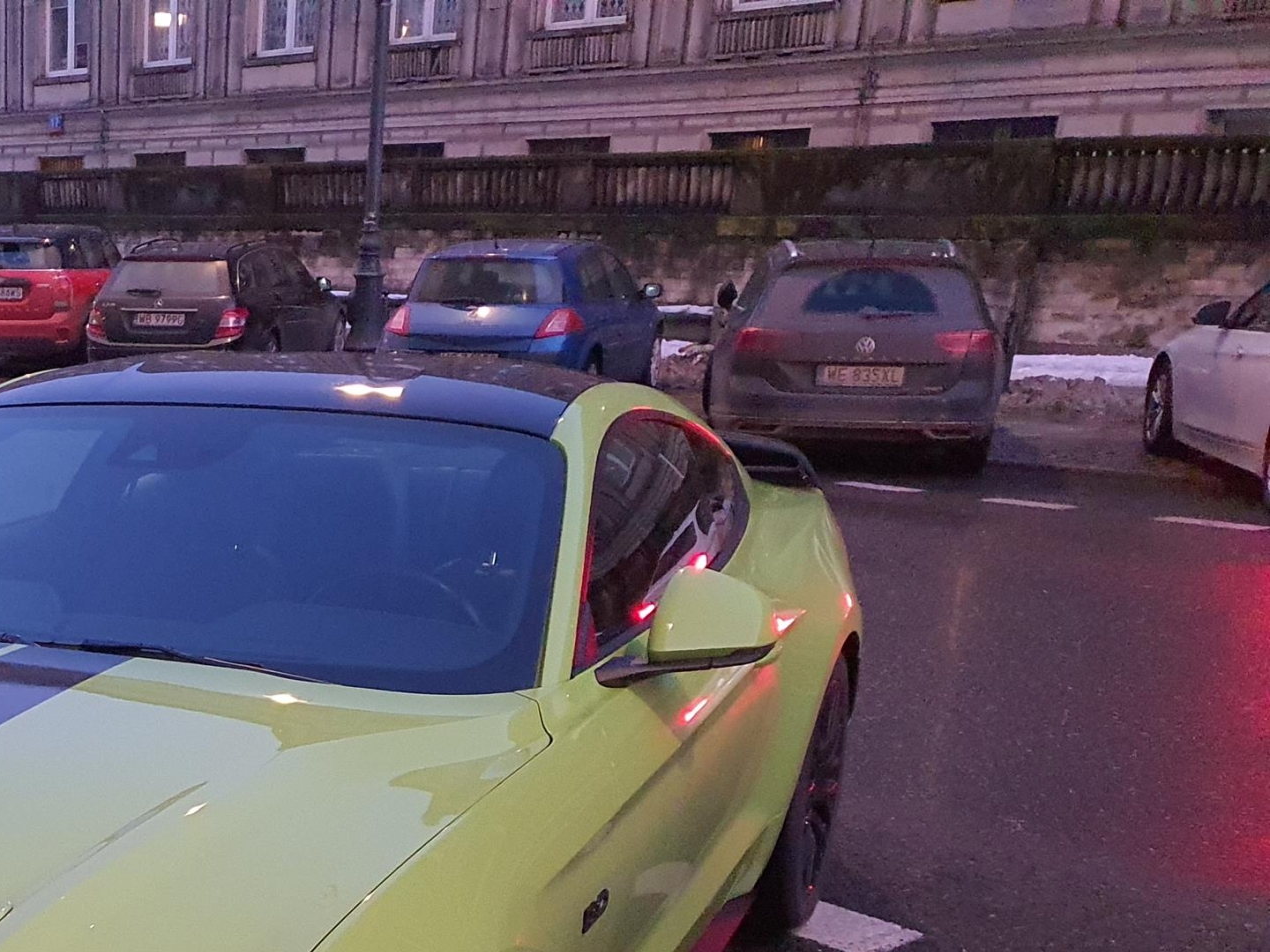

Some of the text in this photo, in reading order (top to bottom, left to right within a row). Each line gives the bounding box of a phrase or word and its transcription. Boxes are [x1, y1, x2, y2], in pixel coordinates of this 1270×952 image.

[139, 313, 151, 323] WB
[827, 366, 898, 383] WE 835XL
